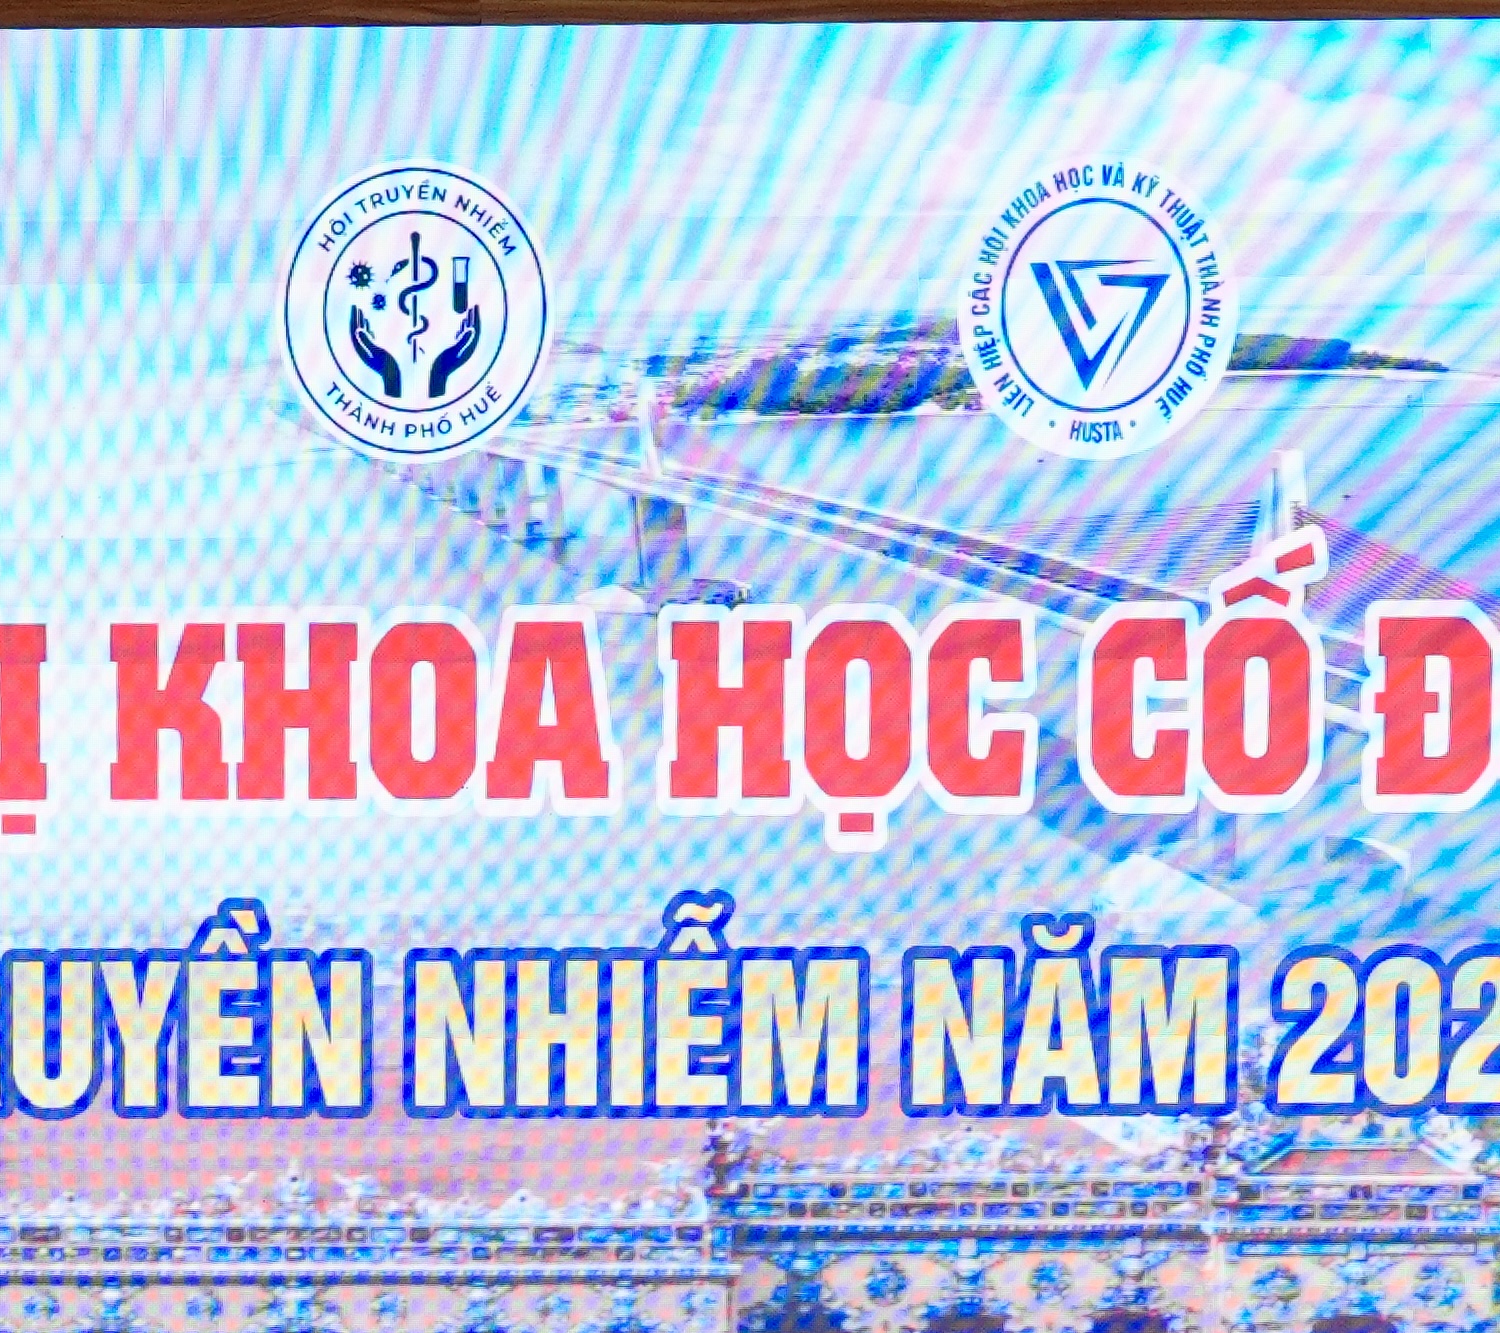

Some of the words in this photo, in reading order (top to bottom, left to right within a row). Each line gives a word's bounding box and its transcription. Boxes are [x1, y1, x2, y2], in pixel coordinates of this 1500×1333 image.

[318, 212, 353, 252] HỘI
[354, 179, 446, 214] TRUYỀN
[455, 194, 516, 256] NHIỄM
[326, 382, 395, 435] THÀNH
[405, 411, 452, 437] PHỐ
[461, 380, 501, 425] HUẾ
[1070, 420, 1123, 443] HUSTA
[109, 622, 610, 803] KHOA
[670, 622, 1019, 831] HỌC
[1090, 539, 1317, 800] CỐ
[412, 892, 866, 1118] NHIỄM
[909, 913, 1228, 1114] NĂM
